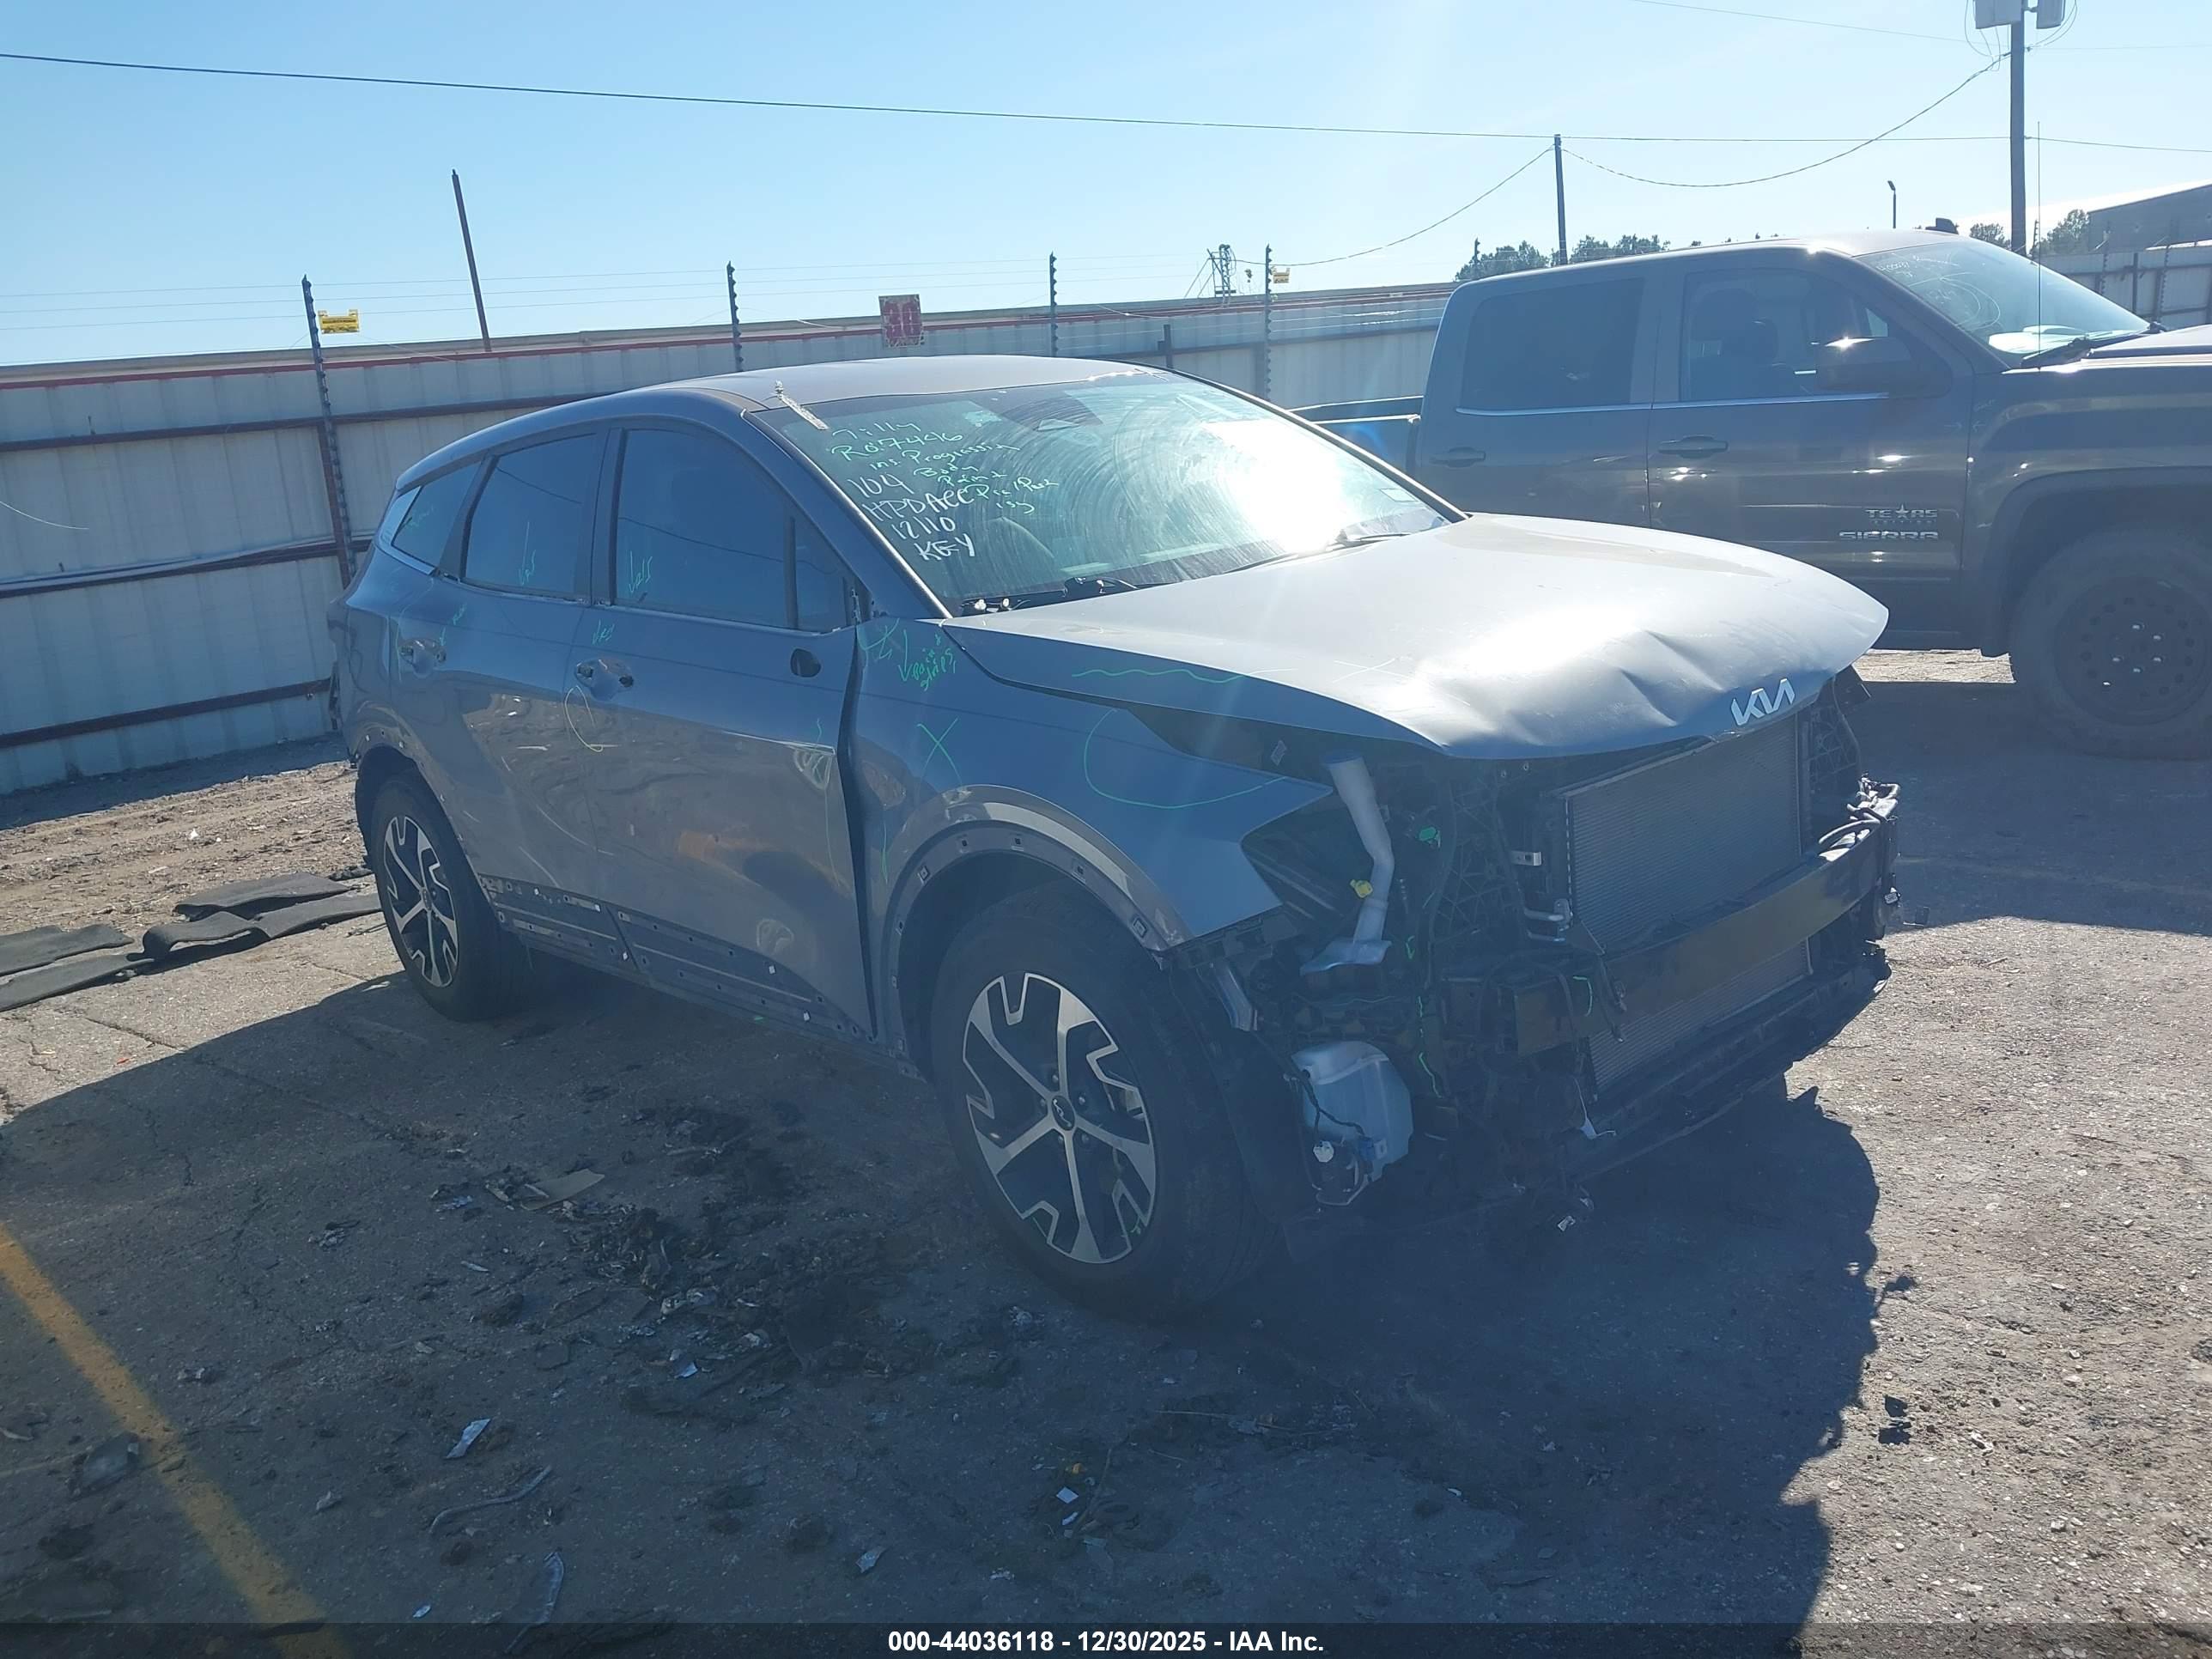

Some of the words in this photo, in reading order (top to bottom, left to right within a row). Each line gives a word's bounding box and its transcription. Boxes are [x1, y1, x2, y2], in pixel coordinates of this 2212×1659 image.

[913, 532, 976, 561] KEY
[1838, 531, 1939, 541] SIERRA
[1730, 678, 1796, 726] KIA
